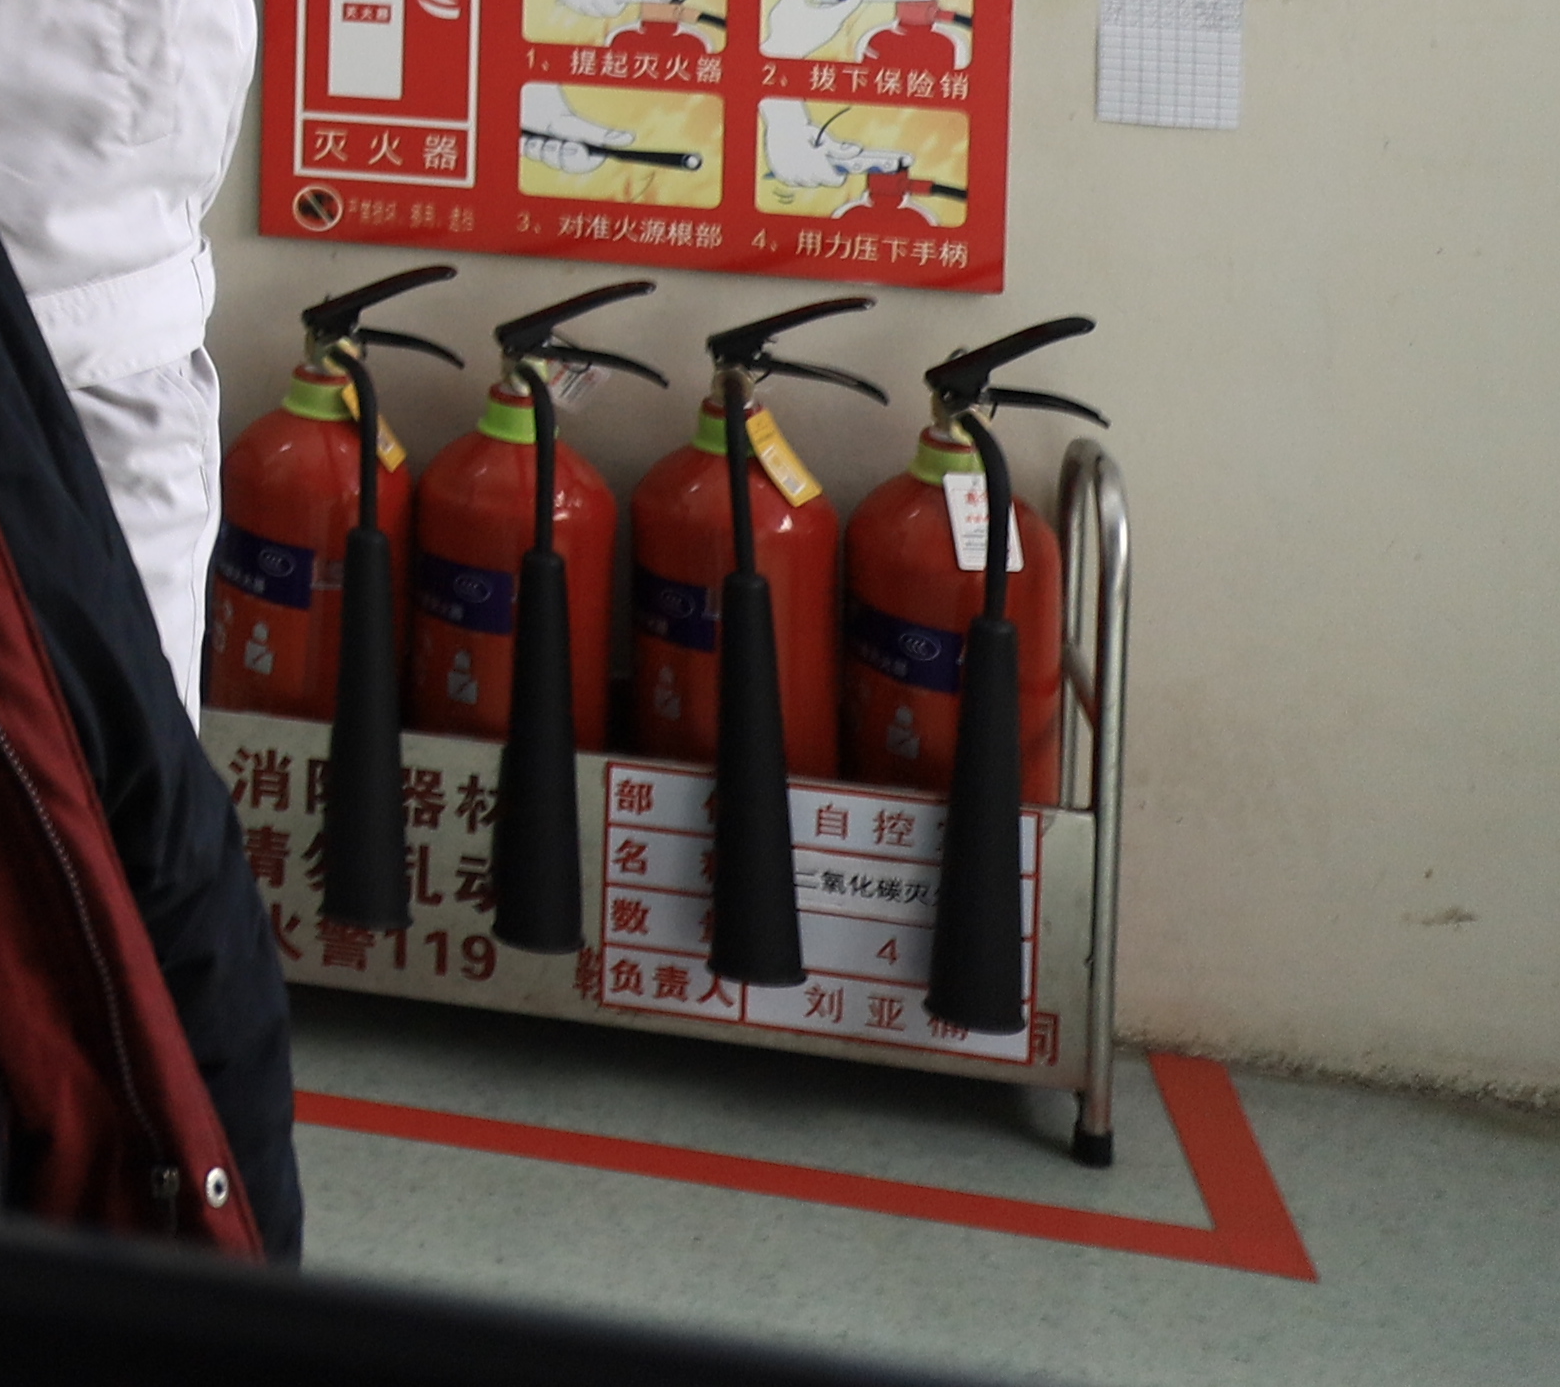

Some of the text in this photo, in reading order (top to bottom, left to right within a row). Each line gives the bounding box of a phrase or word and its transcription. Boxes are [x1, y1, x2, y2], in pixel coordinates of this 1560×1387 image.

[345, 3, 390, 21] 灭火器
[313, 129, 460, 172] 灭火器
[815, 803, 948, 851] 自控
[876, 937, 900, 966] 4
[609, 957, 735, 1010] 负责人
